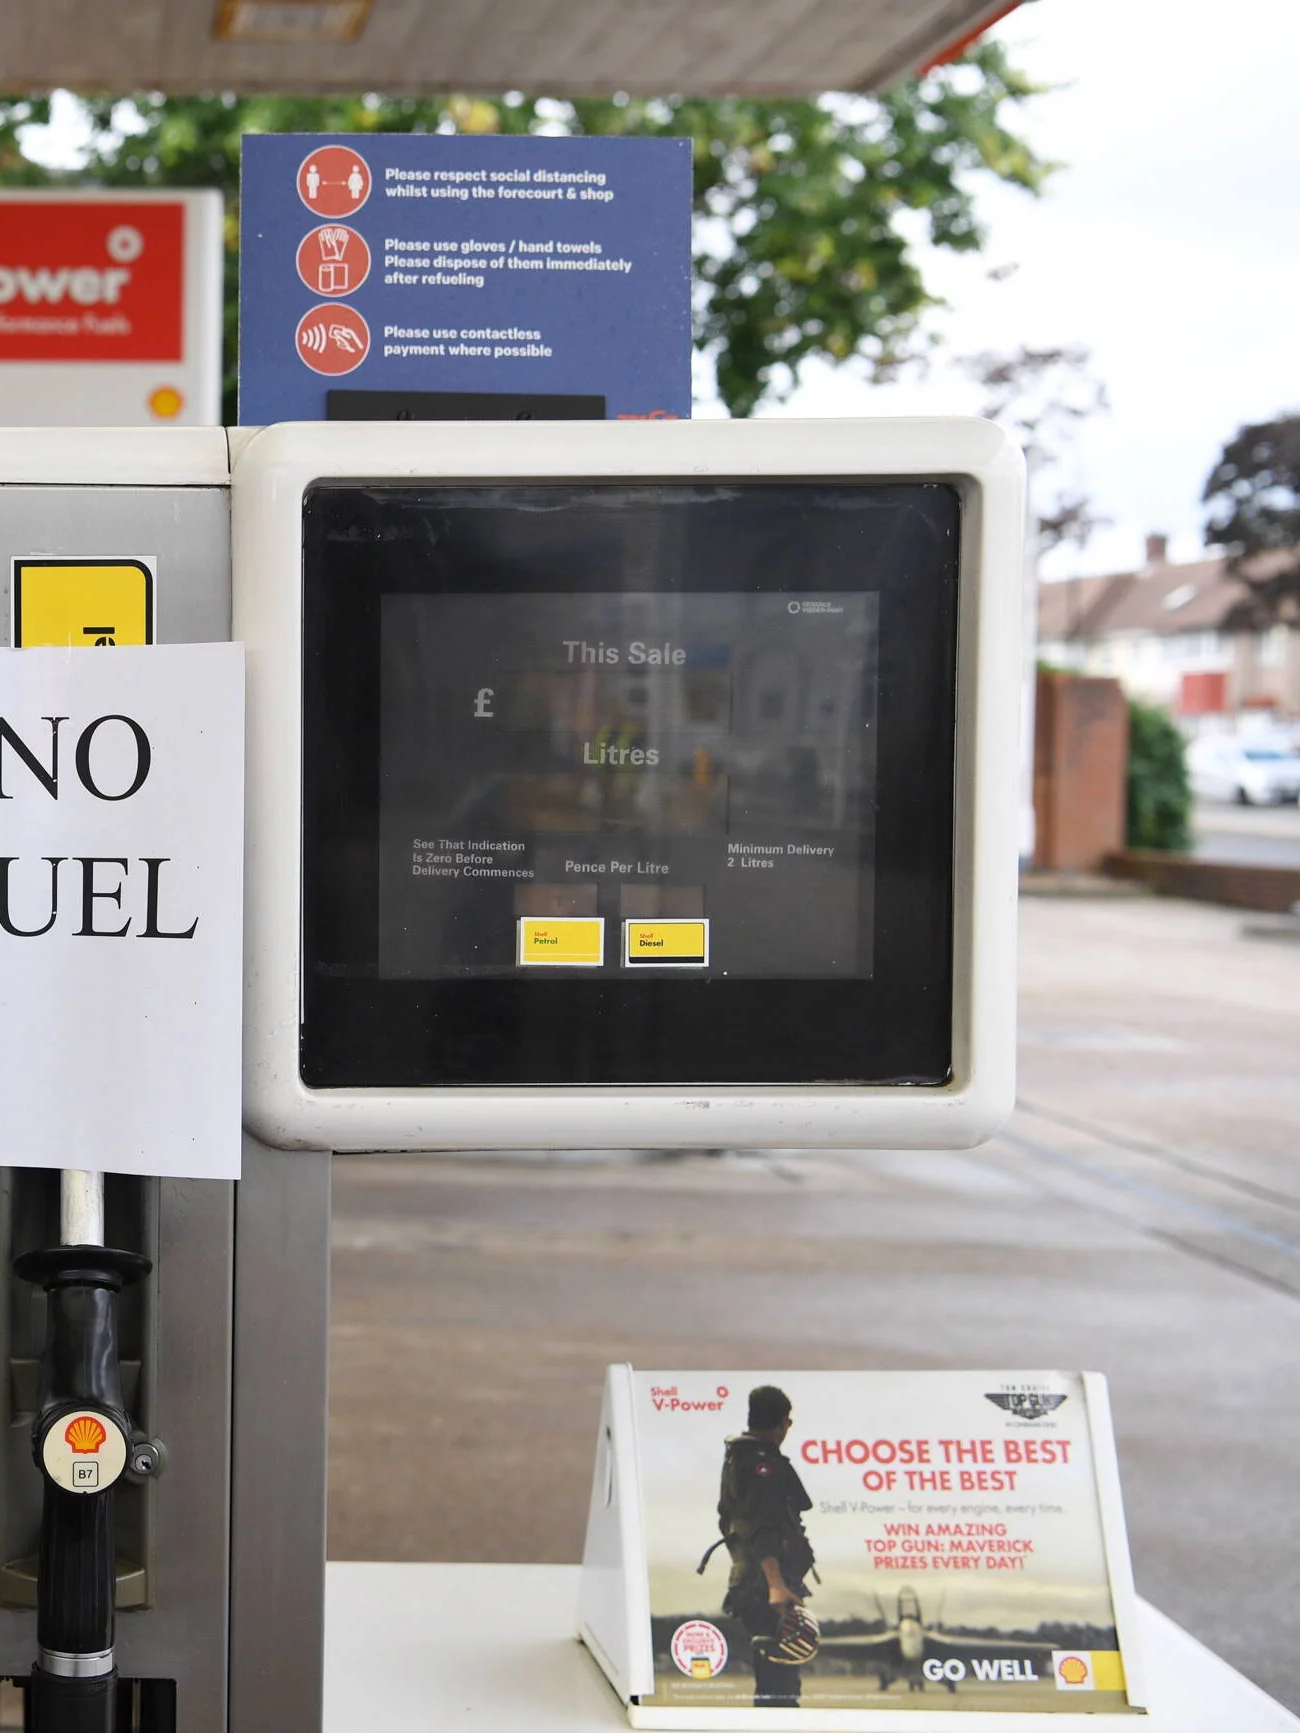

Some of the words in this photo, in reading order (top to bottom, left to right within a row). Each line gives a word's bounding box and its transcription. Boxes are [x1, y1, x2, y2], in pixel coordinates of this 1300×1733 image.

[385, 168, 431, 181] Please
[434, 169, 487, 183] respect
[490, 170, 531, 183] social
[533, 170, 606, 186] distancing
[385, 185, 428, 198] whilst
[431, 186, 469, 200] using
[472, 186, 495, 198] the
[498, 187, 563, 200] forecourt
[566, 188, 576, 200] &
[580, 187, 614, 202] shop
[385, 239, 431, 251] Please
[433, 241, 458, 252] use
[461, 239, 505, 255] gloves
[519, 240, 553, 253] hand
[556, 241, 602, 254] towels
[385, 255, 431, 268] Please
[433, 256, 487, 270] dispose
[490, 257, 505, 268] of
[507, 257, 543, 270] them
[546, 257, 632, 273] immediately
[384, 272, 419, 285] after
[422, 273, 484, 288] refueling
[384, 326, 431, 339] Please
[433, 328, 458, 339] use
[460, 327, 541, 340] contactless
[384, 344, 445, 358] payment
[448, 344, 491, 357] where
[494, 344, 552, 358] possible
[562, 640, 620, 664] This
[627, 641, 687, 665] Sale
[474, 687, 494, 718] £
[583, 742, 660, 765] Litres
[413, 839, 435, 849] See
[438, 839, 465, 850] That
[468, 840, 525, 851] Indication
[727, 843, 783, 855] Minimum
[787, 844, 834, 857] Delivery
[412, 852, 422, 863] Is
[425, 852, 452, 863] Zero
[455, 853, 493, 864] Before
[727, 857, 735, 868] 2
[741, 858, 774, 869] Litres
[412, 865, 460, 878] Delivery
[463, 866, 535, 878] Commences
[565, 861, 606, 873] Pence
[610, 861, 632, 873] Per
[637, 862, 669, 874] Litre
[534, 937, 558, 945] Petrol
[639, 939, 664, 947] Diesel
[651, 1386, 678, 1396] Shell
[652, 1398, 724, 1411] V-Power
[801, 1439, 931, 1465] CHOOSE
[939, 1439, 995, 1464] THE
[1003, 1440, 1071, 1464] BEST
[78, 1469, 93, 1479] B7
[863, 1470, 897, 1491] OF
[904, 1471, 952, 1491] THE
[960, 1471, 1017, 1491] BEST
[820, 1501, 847, 1514] Shell
[908, 1501, 923, 1514] for
[927, 1504, 957, 1517] every
[1006, 1504, 1036, 1517] every
[884, 1523, 920, 1536] WIN
[925, 1523, 1007, 1537] AMAZING
[865, 1540, 896, 1553] TOP
[901, 1540, 945, 1553] GUN:
[949, 1540, 1033, 1553] MAVERICK
[874, 1556, 928, 1570] PRIZES
[932, 1556, 980, 1570] EVERY
[923, 1658, 966, 1682] GO
[971, 1659, 1039, 1681] WELL
